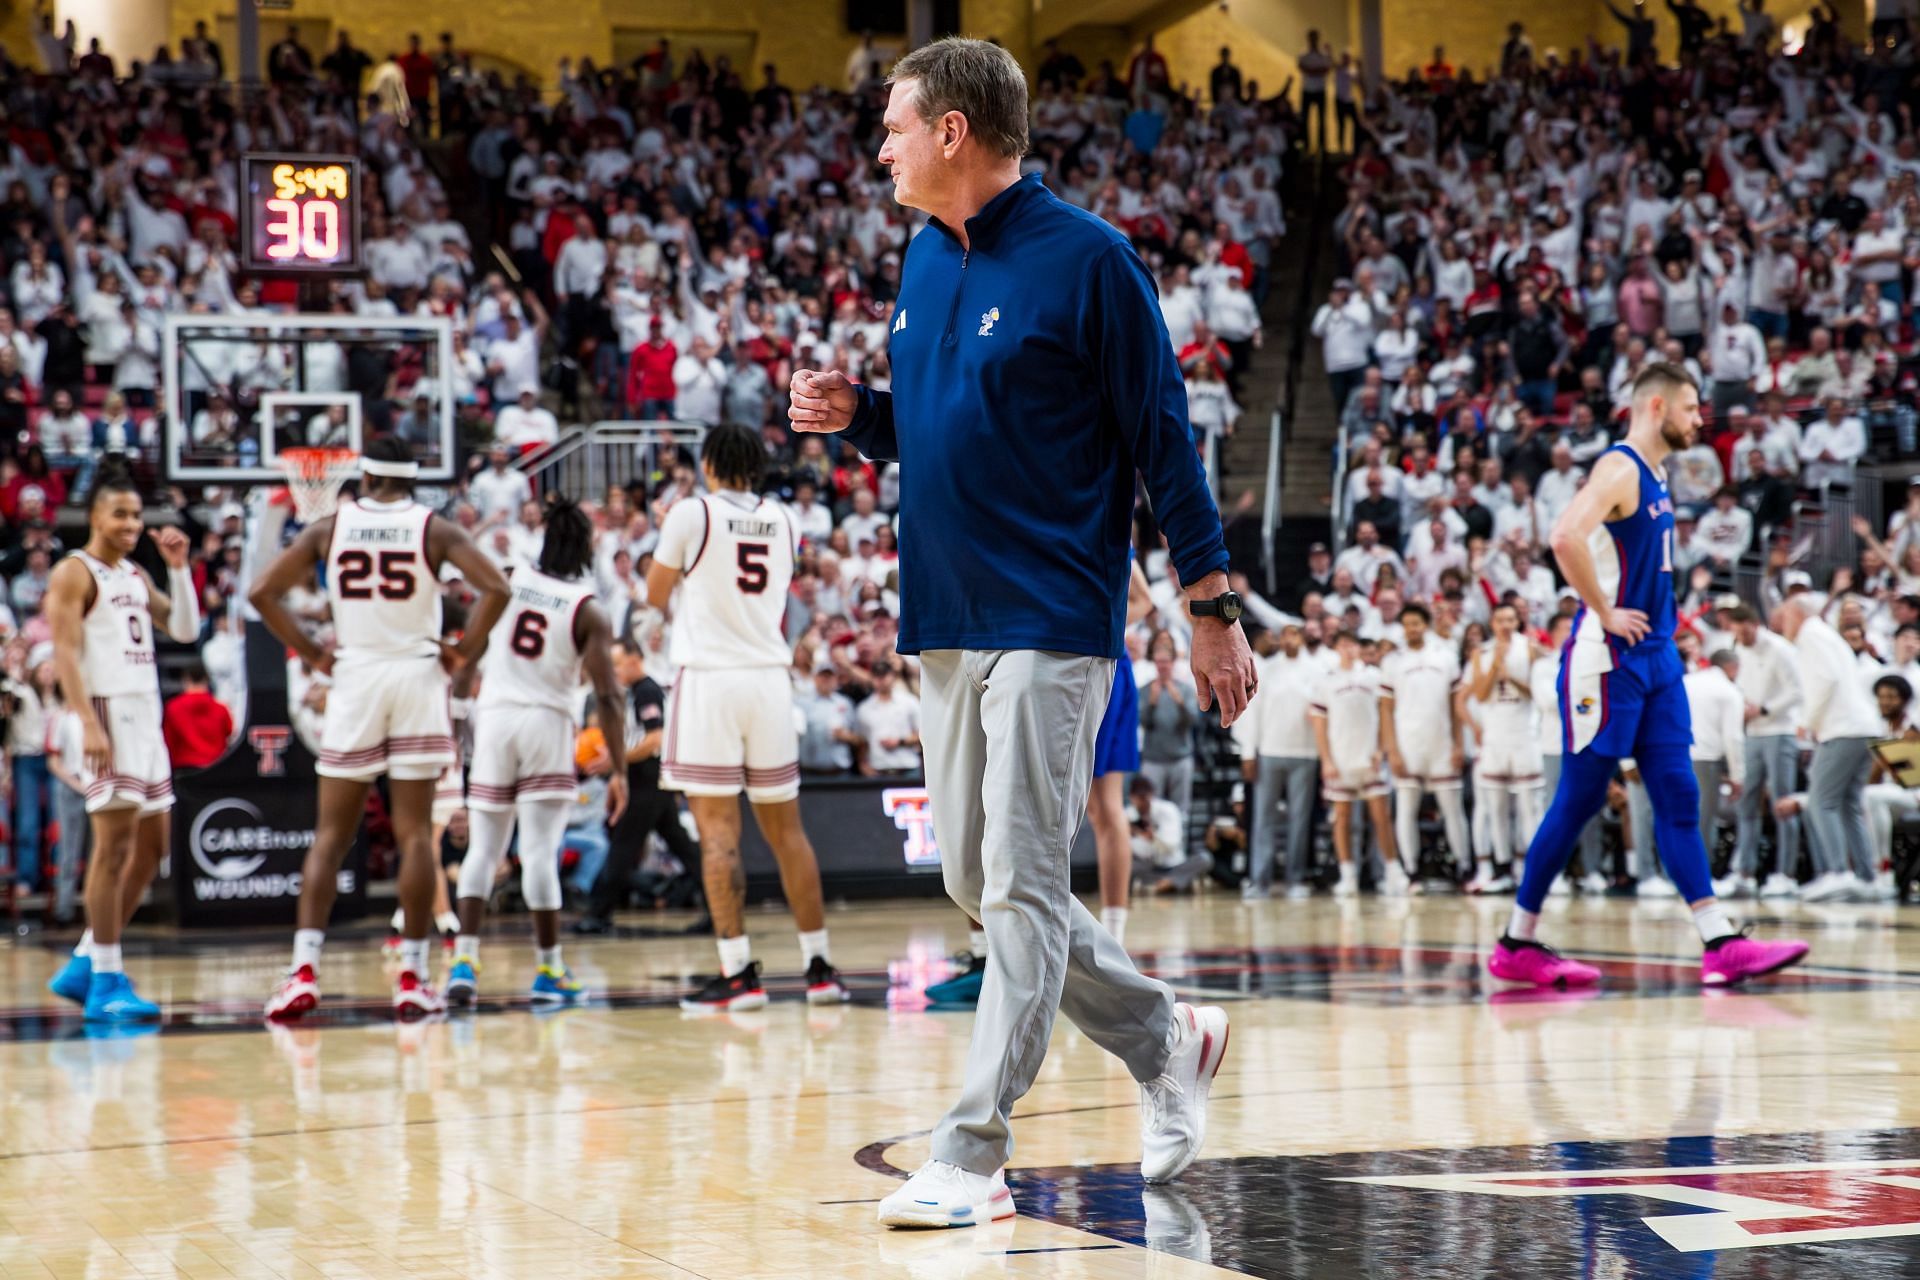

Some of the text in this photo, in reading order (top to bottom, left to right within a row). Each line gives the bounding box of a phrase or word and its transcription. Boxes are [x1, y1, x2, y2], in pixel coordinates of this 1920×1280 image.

[273, 164, 347, 199] 5:49
[266, 200, 339, 258] 30
[727, 518, 777, 537] WILLIAMS
[337, 550, 417, 600] 25
[736, 542, 769, 594] 5
[128, 614, 142, 644] 0
[511, 609, 548, 659] 6
[193, 870, 356, 900] WOUNDCE
